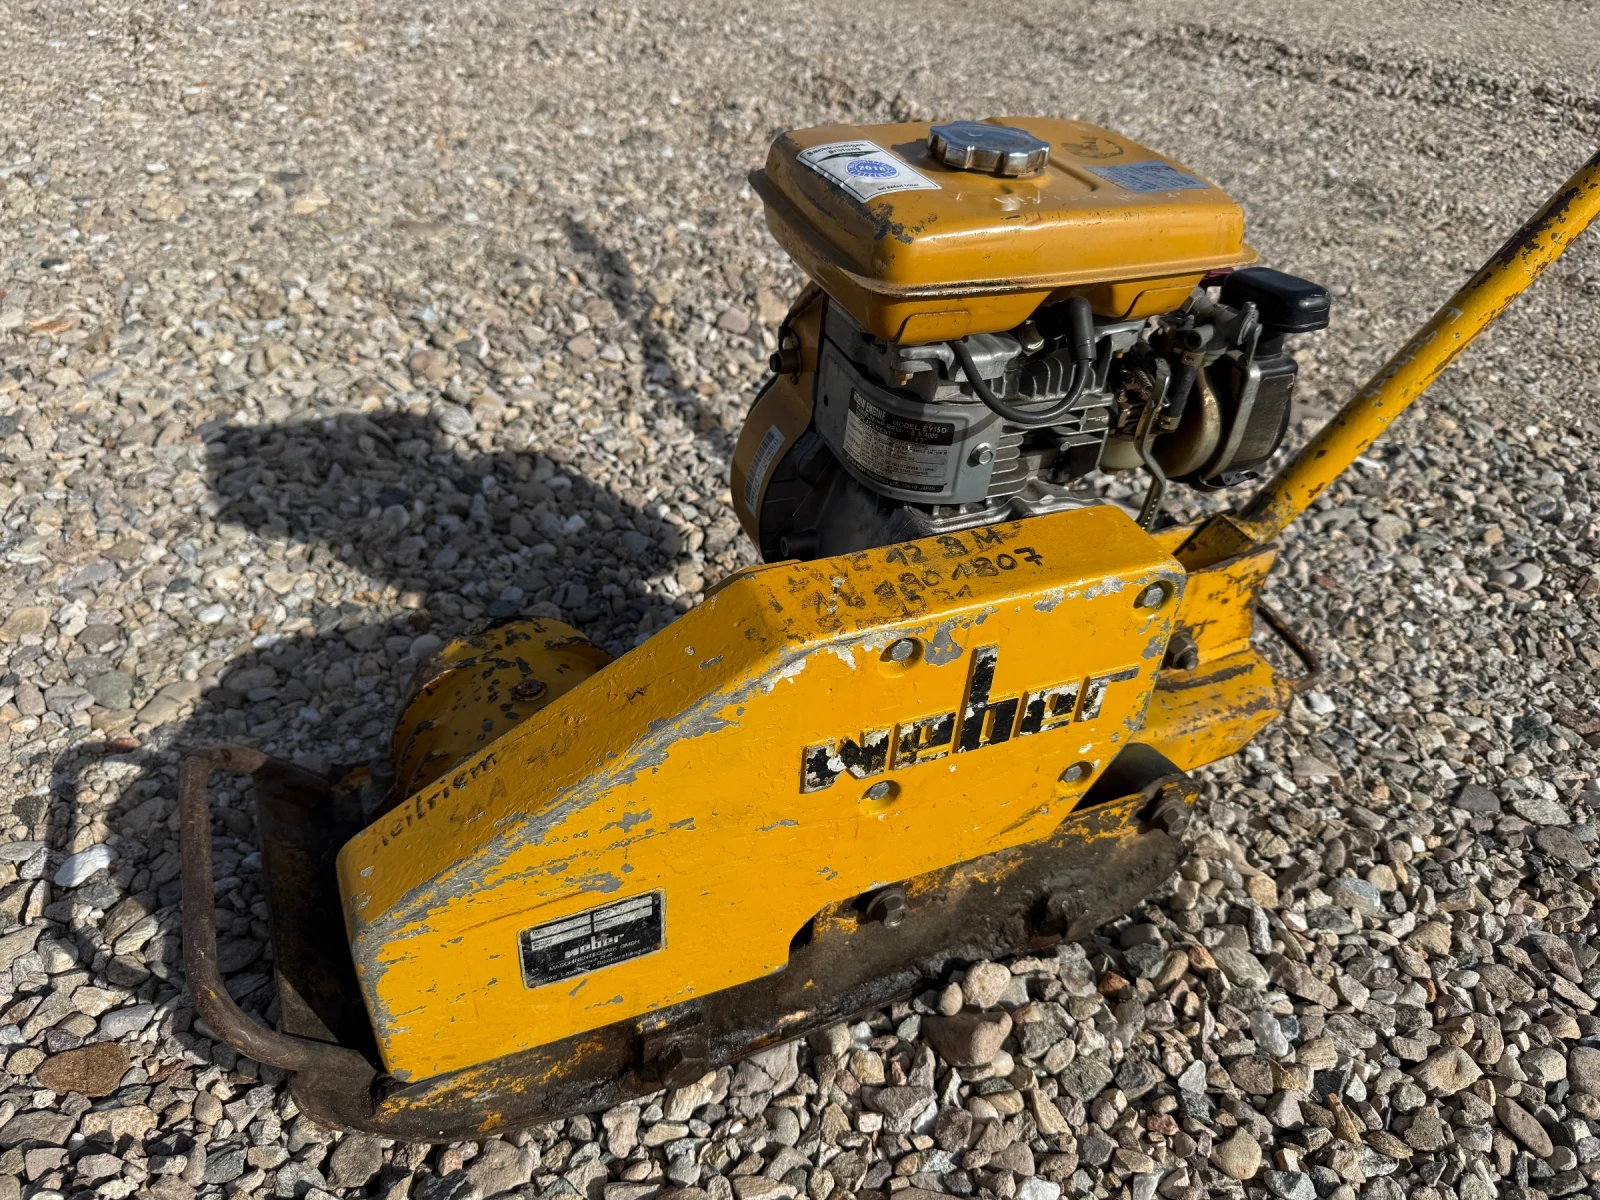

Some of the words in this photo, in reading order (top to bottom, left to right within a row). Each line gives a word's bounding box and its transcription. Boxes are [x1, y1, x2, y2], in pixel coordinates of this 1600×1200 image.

[866, 402, 887, 422] ENGINE
[892, 420, 920, 431] MODEL
[922, 425, 947, 434] EY15D
[799, 642, 1141, 794] weber
[564, 933, 625, 959] weber
